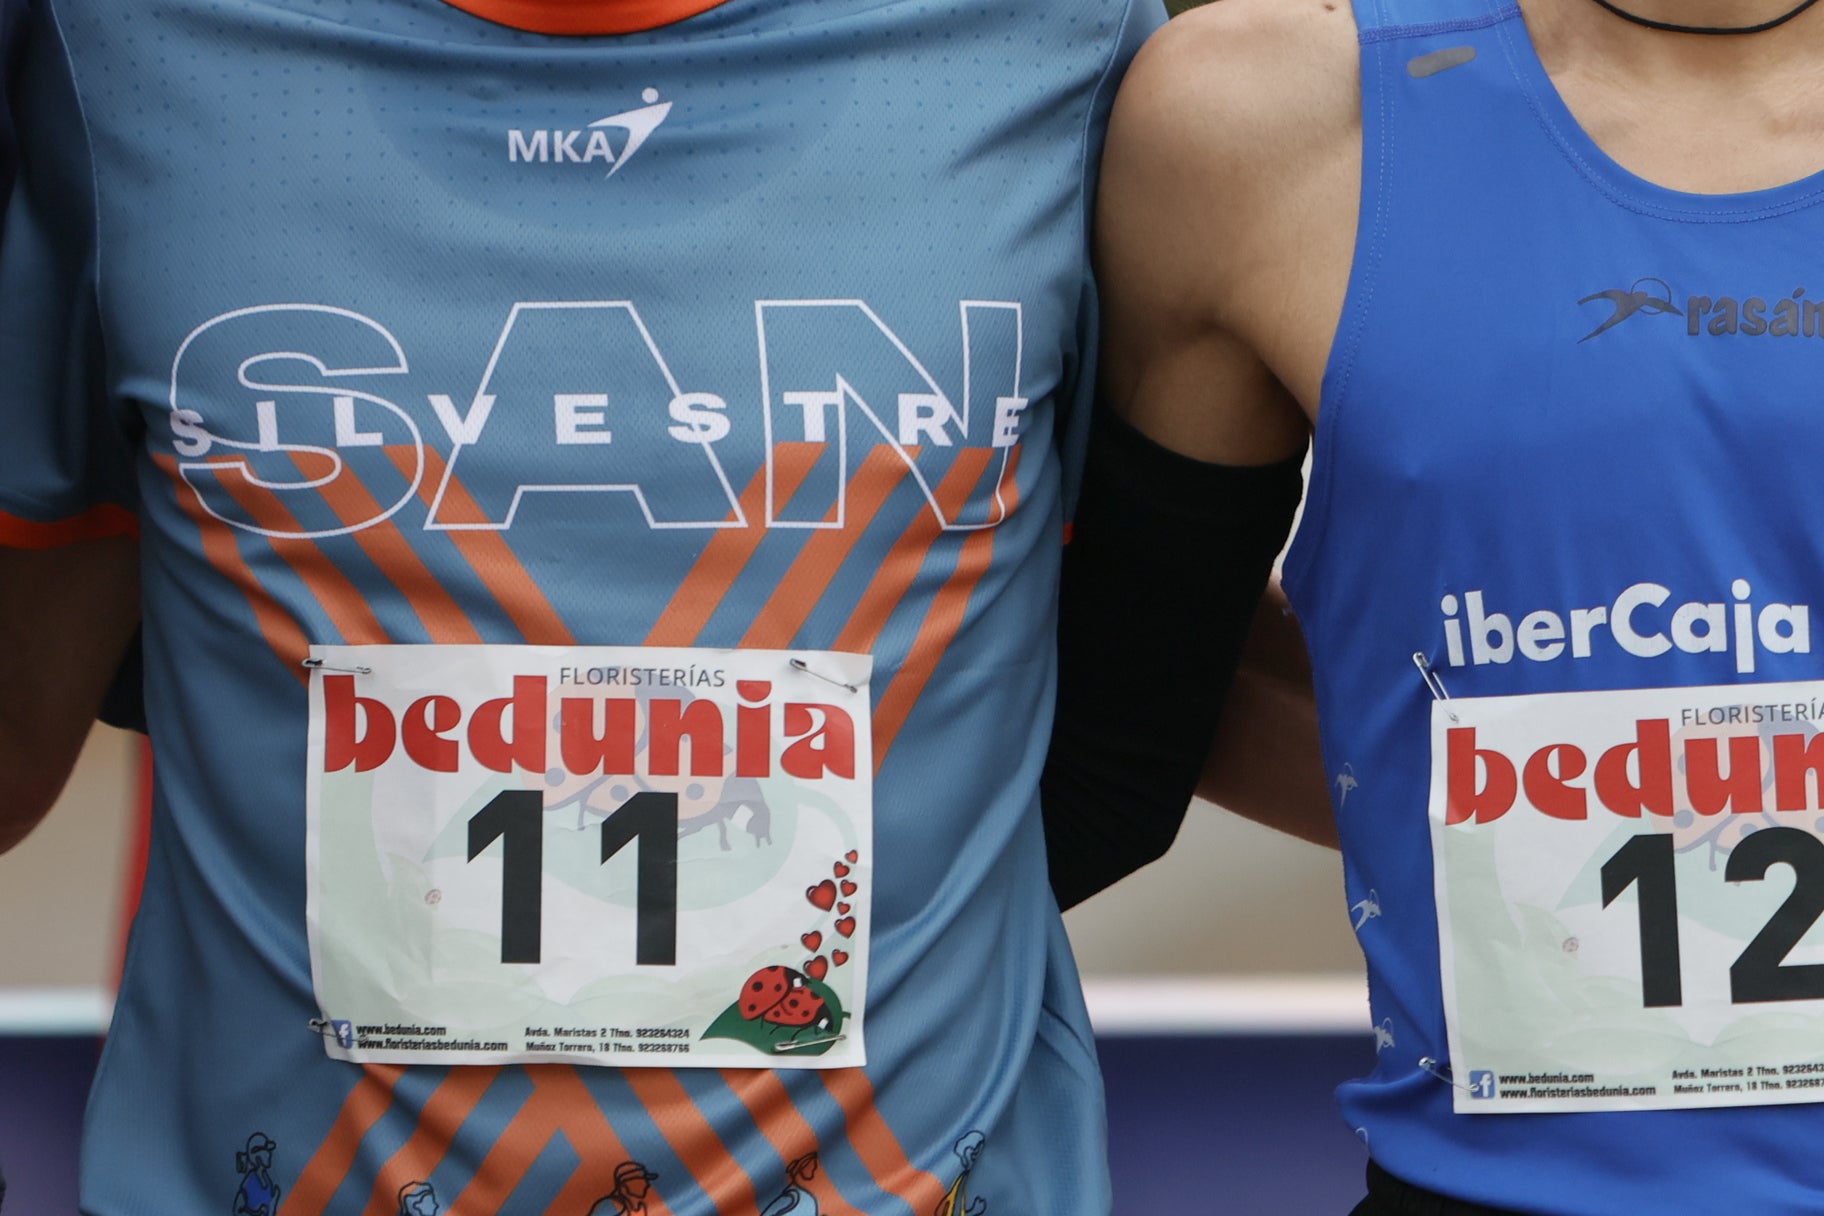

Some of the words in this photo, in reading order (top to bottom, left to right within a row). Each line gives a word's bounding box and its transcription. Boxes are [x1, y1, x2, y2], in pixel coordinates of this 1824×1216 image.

[507, 129, 617, 164] MKA
[170, 389, 1029, 457] SILVESTRE
[171, 300, 1022, 539] SAN
[1440, 578, 1810, 673] iberCaja
[560, 664, 725, 688] FLORISTERÍAS
[323, 675, 855, 780] bedunia
[467, 790, 679, 966] 11
[356, 1024, 447, 1036] www.bedunia.com
[554, 1027, 597, 1038] Maristas
[1499, 1072, 1595, 1085] www.bedunia.com
[1701, 1068, 1743, 1078] Maristas
[1500, 1086, 1656, 1099] www.floristeriasbedunia.com
